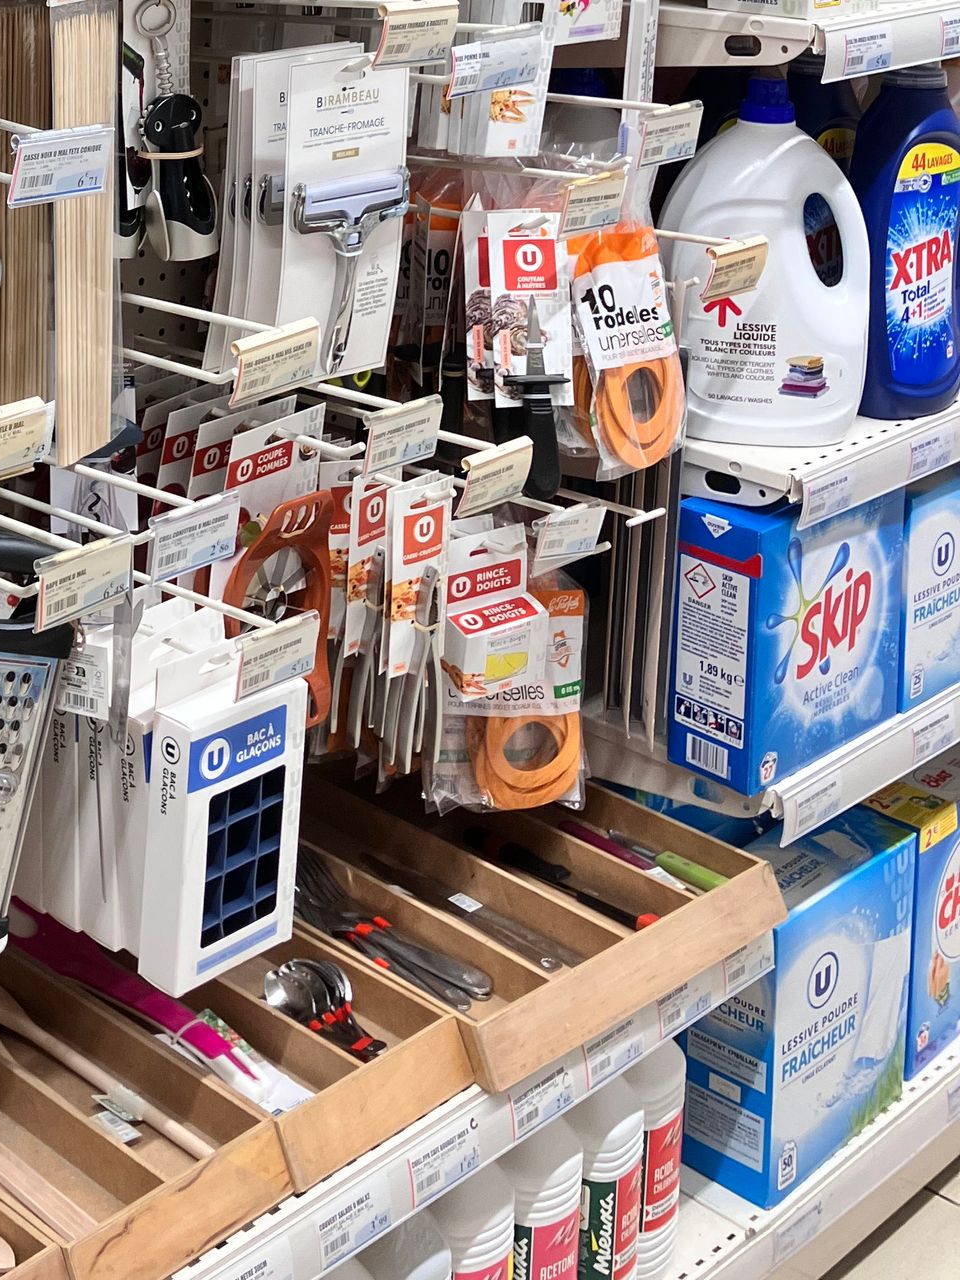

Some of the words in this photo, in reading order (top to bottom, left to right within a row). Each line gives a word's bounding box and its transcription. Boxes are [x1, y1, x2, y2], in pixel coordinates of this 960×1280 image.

[316, 89, 380, 109] BIRAMBEAU
[309, 117, 385, 138] TRANCHE-FROMAGE
[911, 152, 927, 171] 44
[927, 153, 953, 169] LAVAGES
[580, 283, 616, 315] 10
[900, 280, 931, 307] Total
[733, 331, 777, 342] LIQUIDE
[736, 323, 777, 334] LESSIVE
[700, 338, 718, 346] TOUS
[719, 340, 737, 348] TYPES
[748, 342, 777, 350] TISSUS
[705, 345, 726, 353] BLANC
[737, 348, 776, 356] COULEURS
[712, 357, 739, 365] LAUNDRY
[740, 360, 775, 368] DETERGENT
[744, 367, 775, 375] CLOTHES
[707, 370, 728, 378] WHITES
[744, 373, 775, 382] COLOURS
[717, 394, 743, 402] LAVAGES
[748, 396, 773, 404] WASHES
[257, 447, 286, 463] COUPE-
[256, 457, 289, 476] POMMES
[476, 566, 508, 582] RINCE-
[476, 574, 512, 592] DOIGTS
[913, 584, 939, 603] LESSIVE
[482, 601, 516, 623] RINCE-
[490, 605, 539, 628] DOIGTS
[796, 567, 872, 680] Skip
[698, 660, 718, 676] 1,89
[803, 678, 830, 704] Active
[833, 666, 859, 690] Clean
[247, 730, 265, 745] BAC
[236, 735, 281, 764] GLAÇONS
[206, 747, 224, 772] U
[782, 1023, 818, 1055] LESSIVE
[820, 992, 858, 1027] POUDRE
[781, 1015, 856, 1078] FRAÎCHEUR
[653, 1160, 674, 1183] ACIDE
